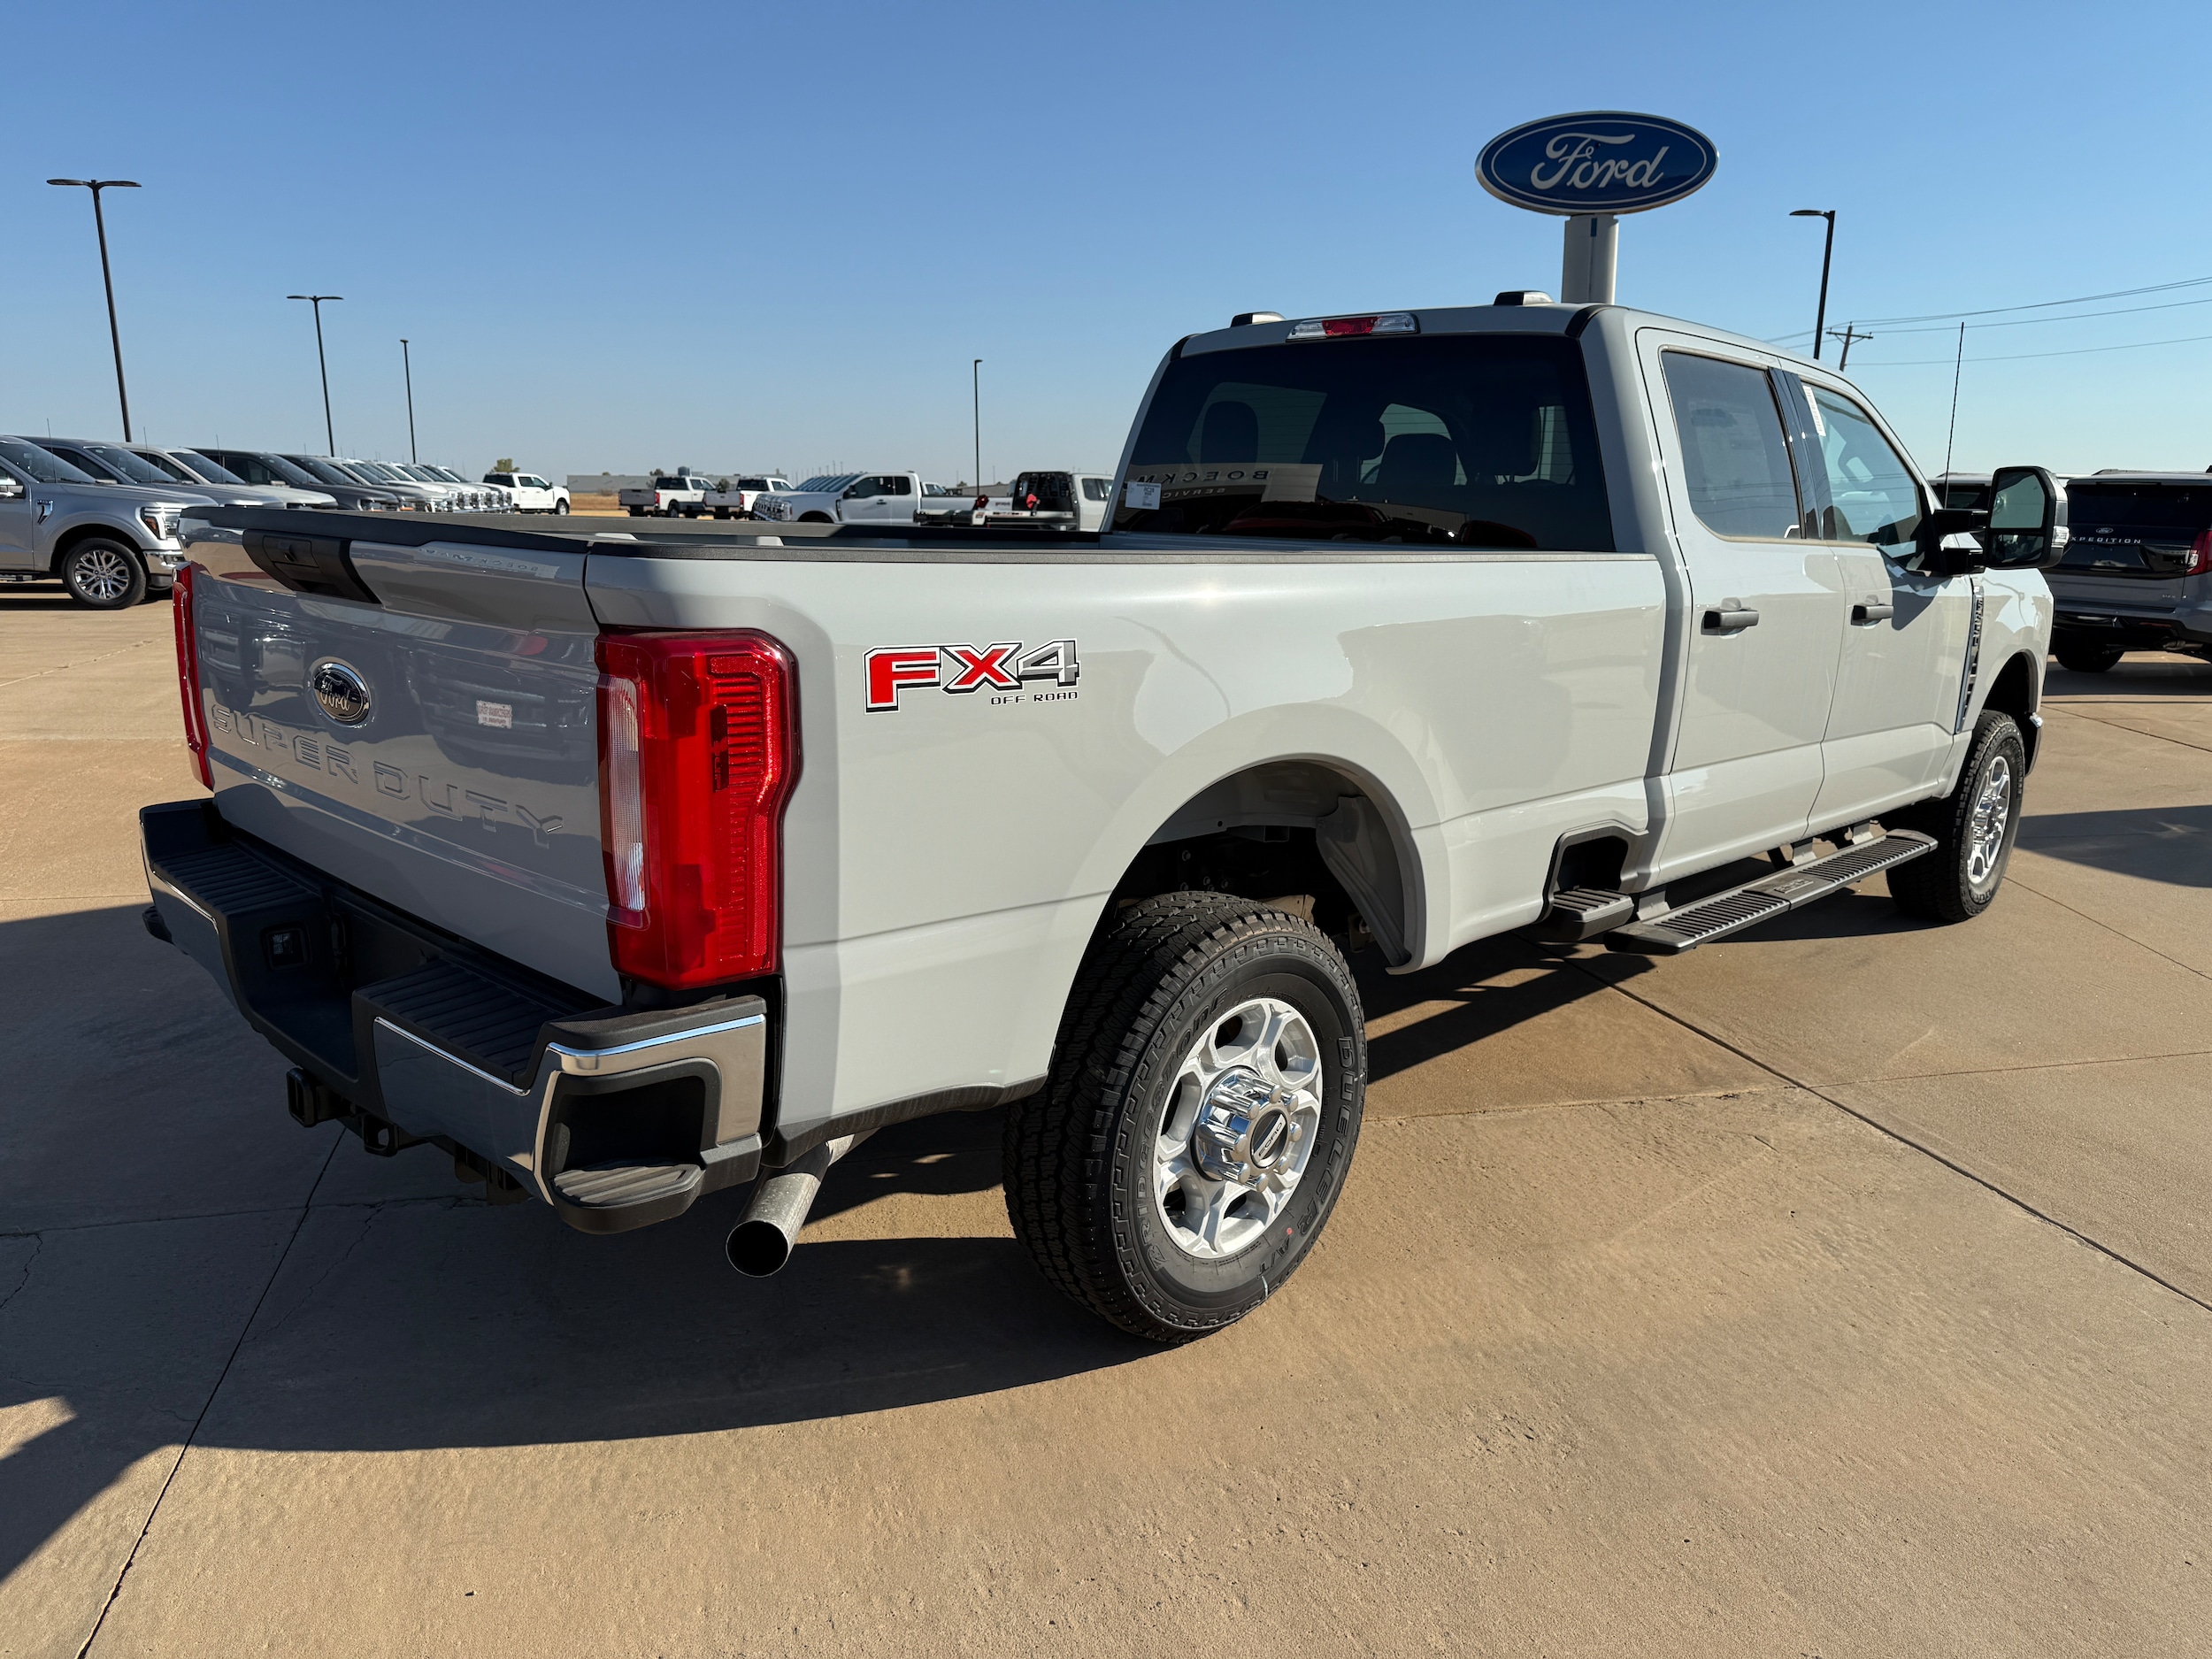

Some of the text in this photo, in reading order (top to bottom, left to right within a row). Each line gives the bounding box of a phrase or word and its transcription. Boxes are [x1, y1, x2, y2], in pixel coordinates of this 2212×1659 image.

[1531, 133, 1670, 189] Ford
[320, 674, 351, 711] Ford
[863, 638, 1080, 715] FX4
[991, 690, 1079, 706] OFF ROAD
[212, 703, 564, 849] SUPER DUTY
[1258, 1122, 1282, 1157] FORD
[1296, 1036, 1355, 1237] DUELER
